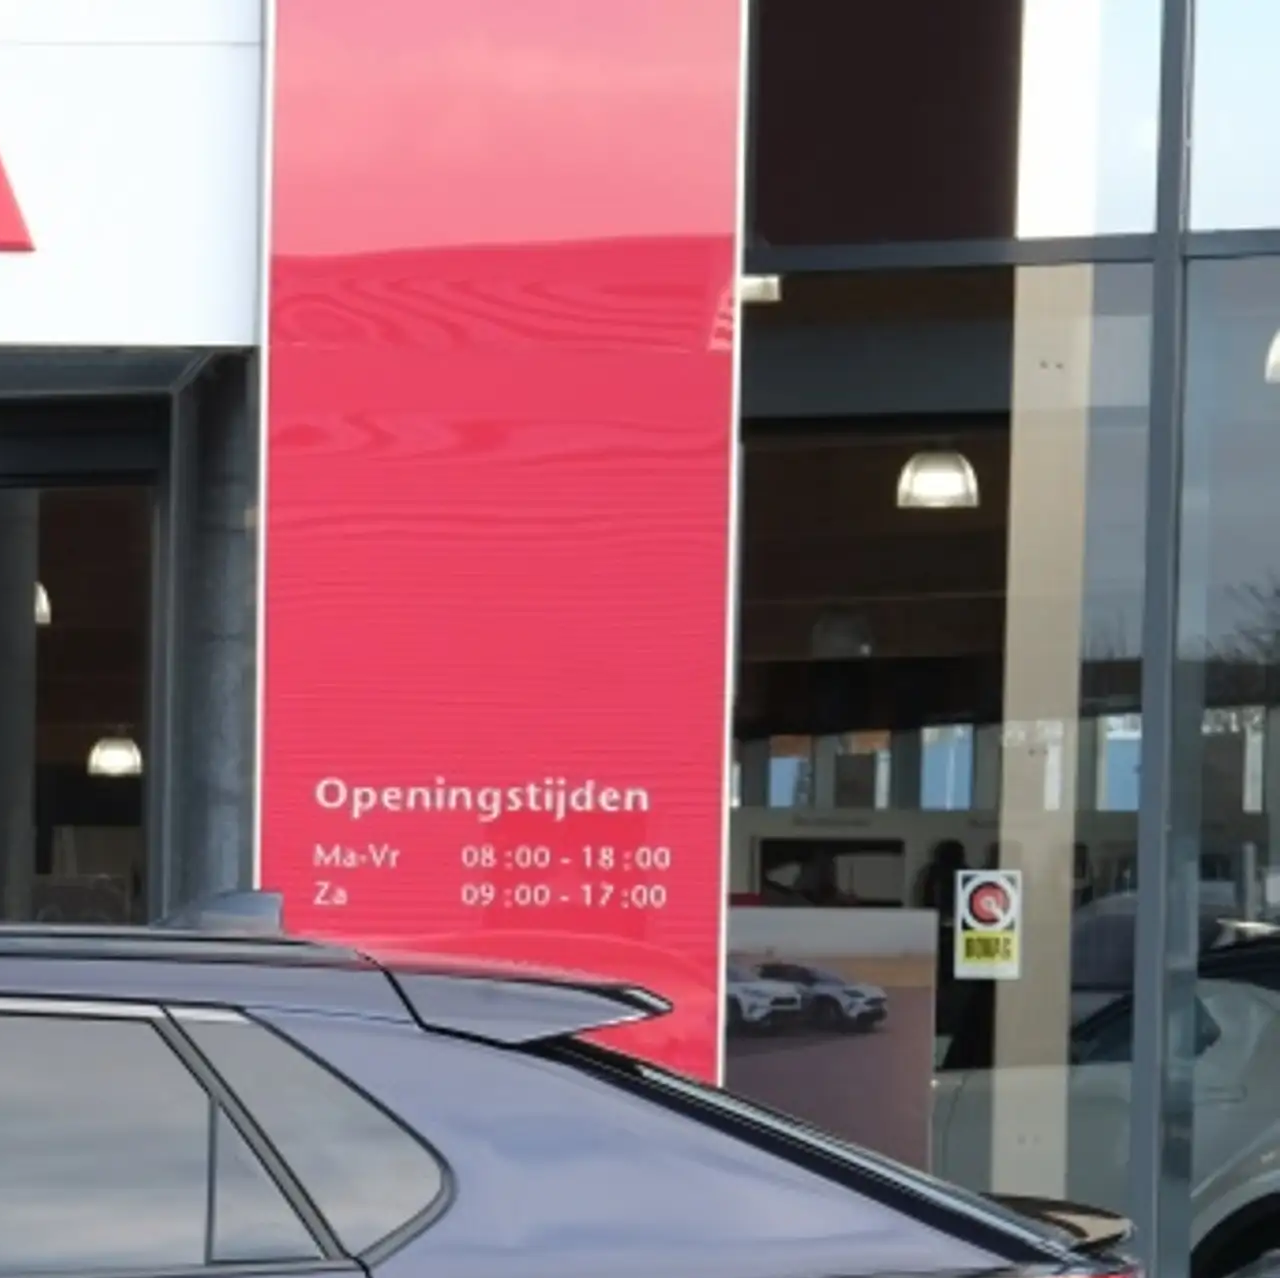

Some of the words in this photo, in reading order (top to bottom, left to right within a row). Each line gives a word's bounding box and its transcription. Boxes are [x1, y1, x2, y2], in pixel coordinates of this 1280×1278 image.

[314, 776, 651, 822] Openingstijden
[313, 844, 401, 869] Ma-Vr
[313, 881, 349, 906] Za
